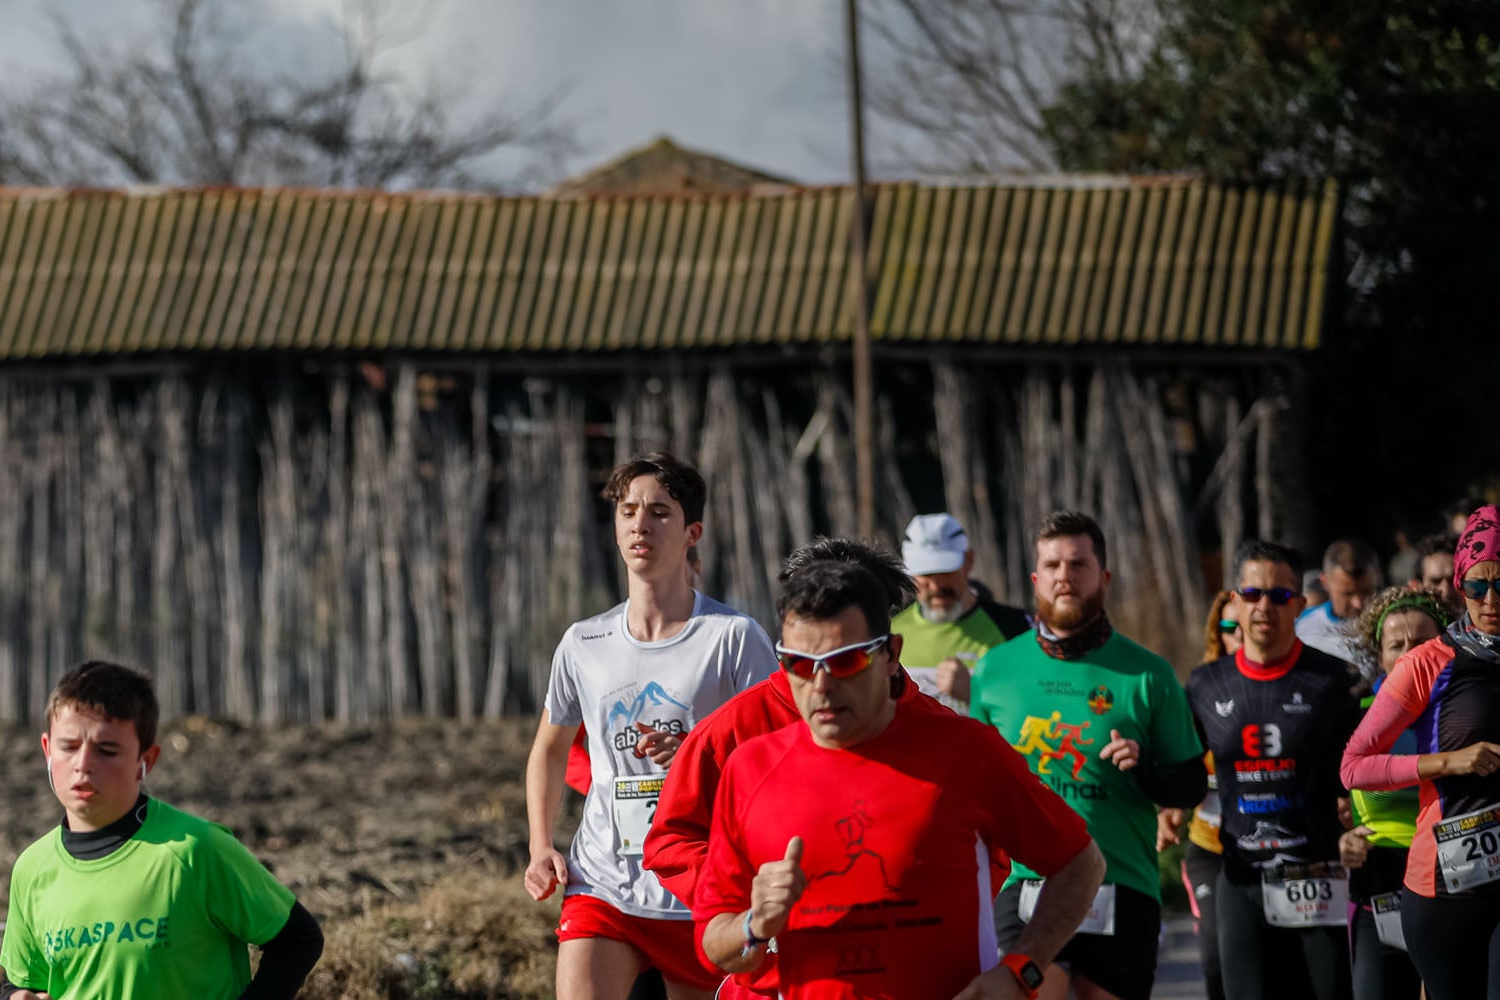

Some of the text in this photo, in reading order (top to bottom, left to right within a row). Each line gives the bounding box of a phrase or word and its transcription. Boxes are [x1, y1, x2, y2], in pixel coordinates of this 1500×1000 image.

[614, 718, 683, 752] abes
[1050, 776, 1108, 800] linas
[1462, 831, 1500, 862] 20
[1287, 880, 1332, 902] 603
